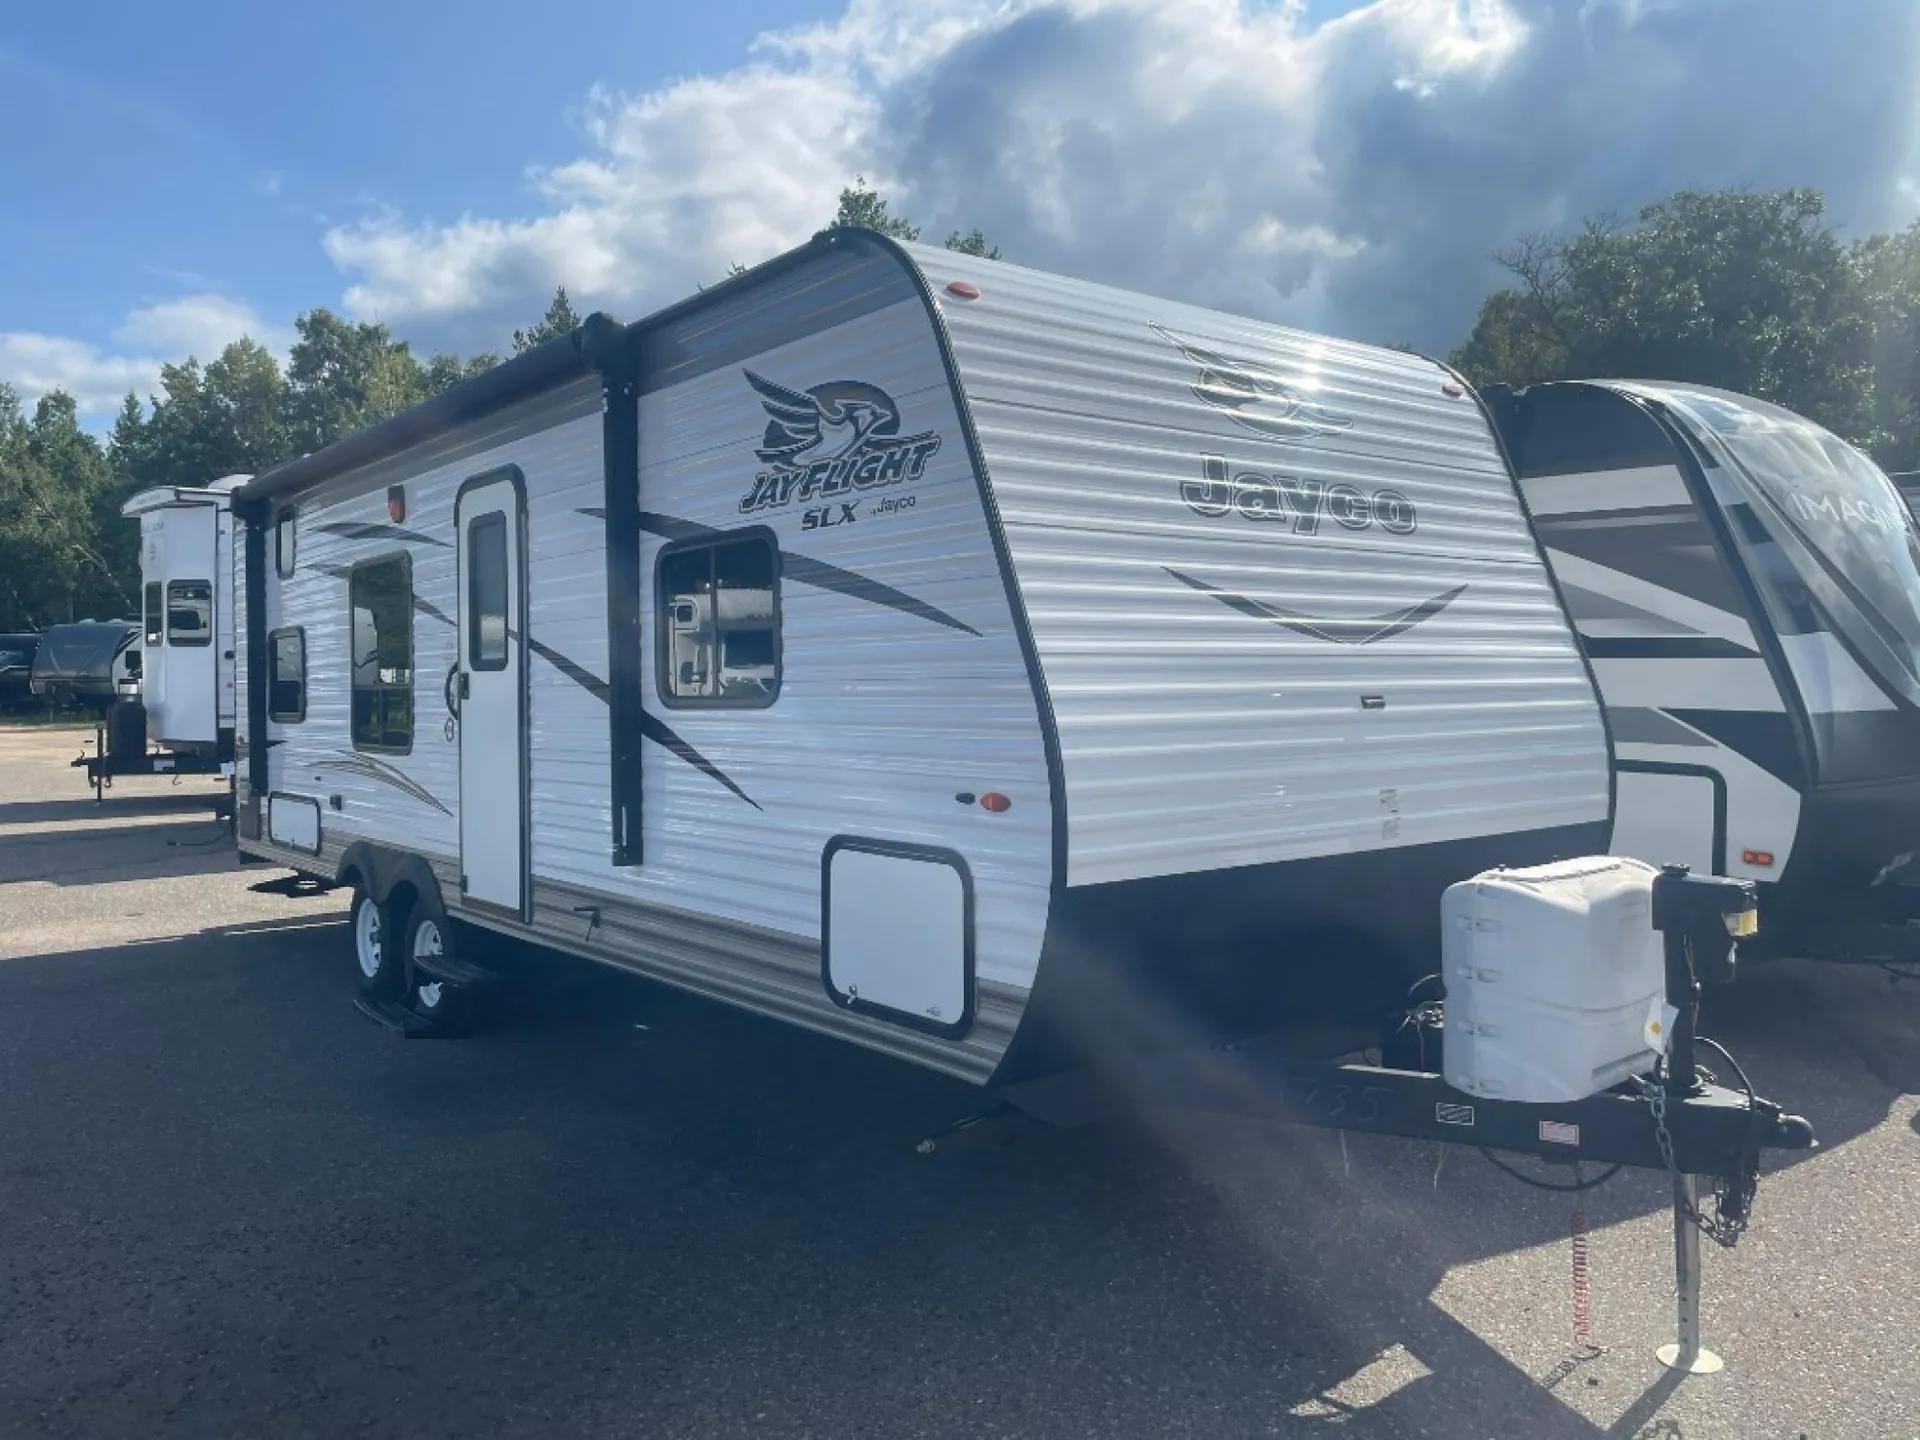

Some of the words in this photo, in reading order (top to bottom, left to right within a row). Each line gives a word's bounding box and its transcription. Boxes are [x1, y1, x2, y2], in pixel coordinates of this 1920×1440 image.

[740, 470, 805, 514] JAY
[799, 435, 941, 501] FLIGHT
[1179, 452, 1418, 536] Jayco
[801, 500, 861, 532] SLX
[876, 495, 916, 514] Jayco
